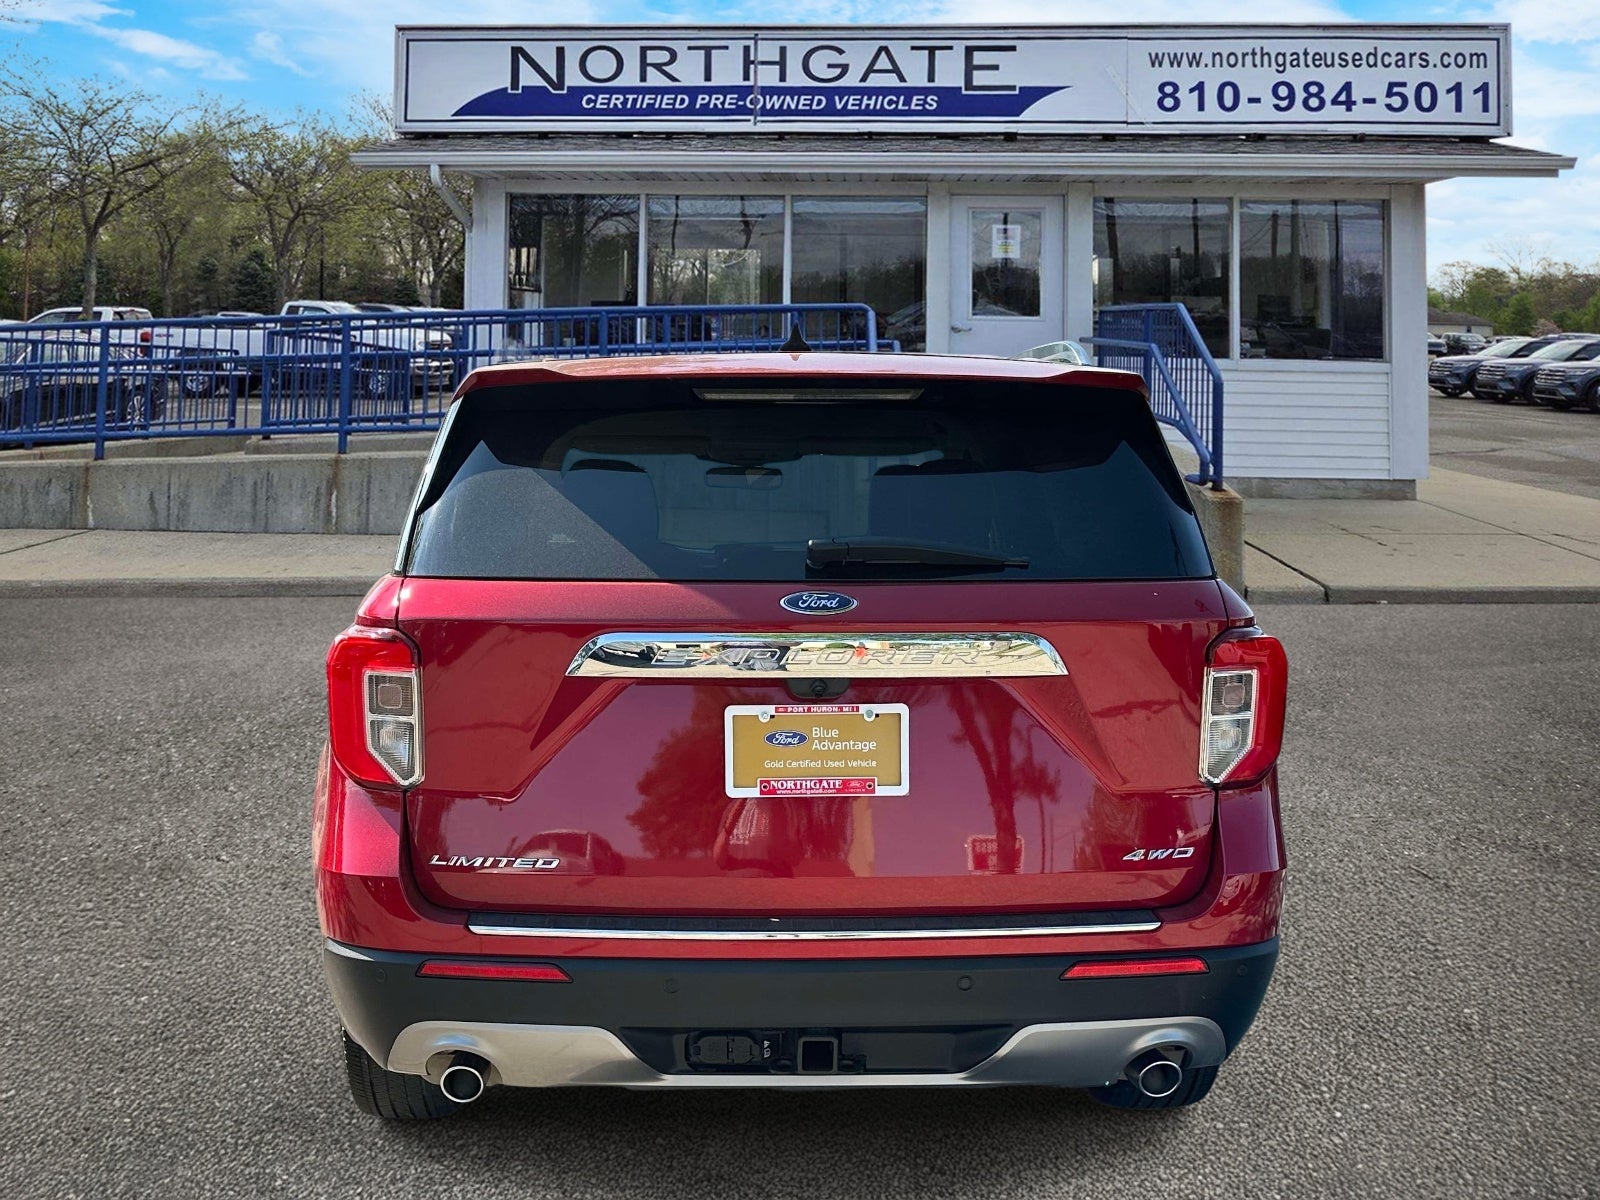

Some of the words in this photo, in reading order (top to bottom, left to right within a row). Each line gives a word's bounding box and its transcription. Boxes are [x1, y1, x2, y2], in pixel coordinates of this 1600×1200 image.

[1148, 47, 1489, 73] www.northgateusedcars.com
[508, 44, 1018, 94] NORTHGATE
[581, 94, 689, 110] CERTIFIED
[695, 94, 826, 111] PRE-OWNED
[833, 95, 939, 111] VEHICLES
[1156, 80, 1492, 114] 810-984-5011
[798, 593, 840, 608] Ford
[650, 648, 979, 666] EXPLORER
[772, 733, 800, 745] Ford
[812, 727, 840, 738] Blue
[812, 740, 877, 752] Advantage
[764, 760, 784, 768] Gold
[786, 760, 822, 768] Certified
[848, 759, 877, 768] Vehicle
[769, 779, 843, 790] NORTHGATE
[1122, 847, 1195, 861] 4WD
[429, 855, 560, 869] LIMITED
